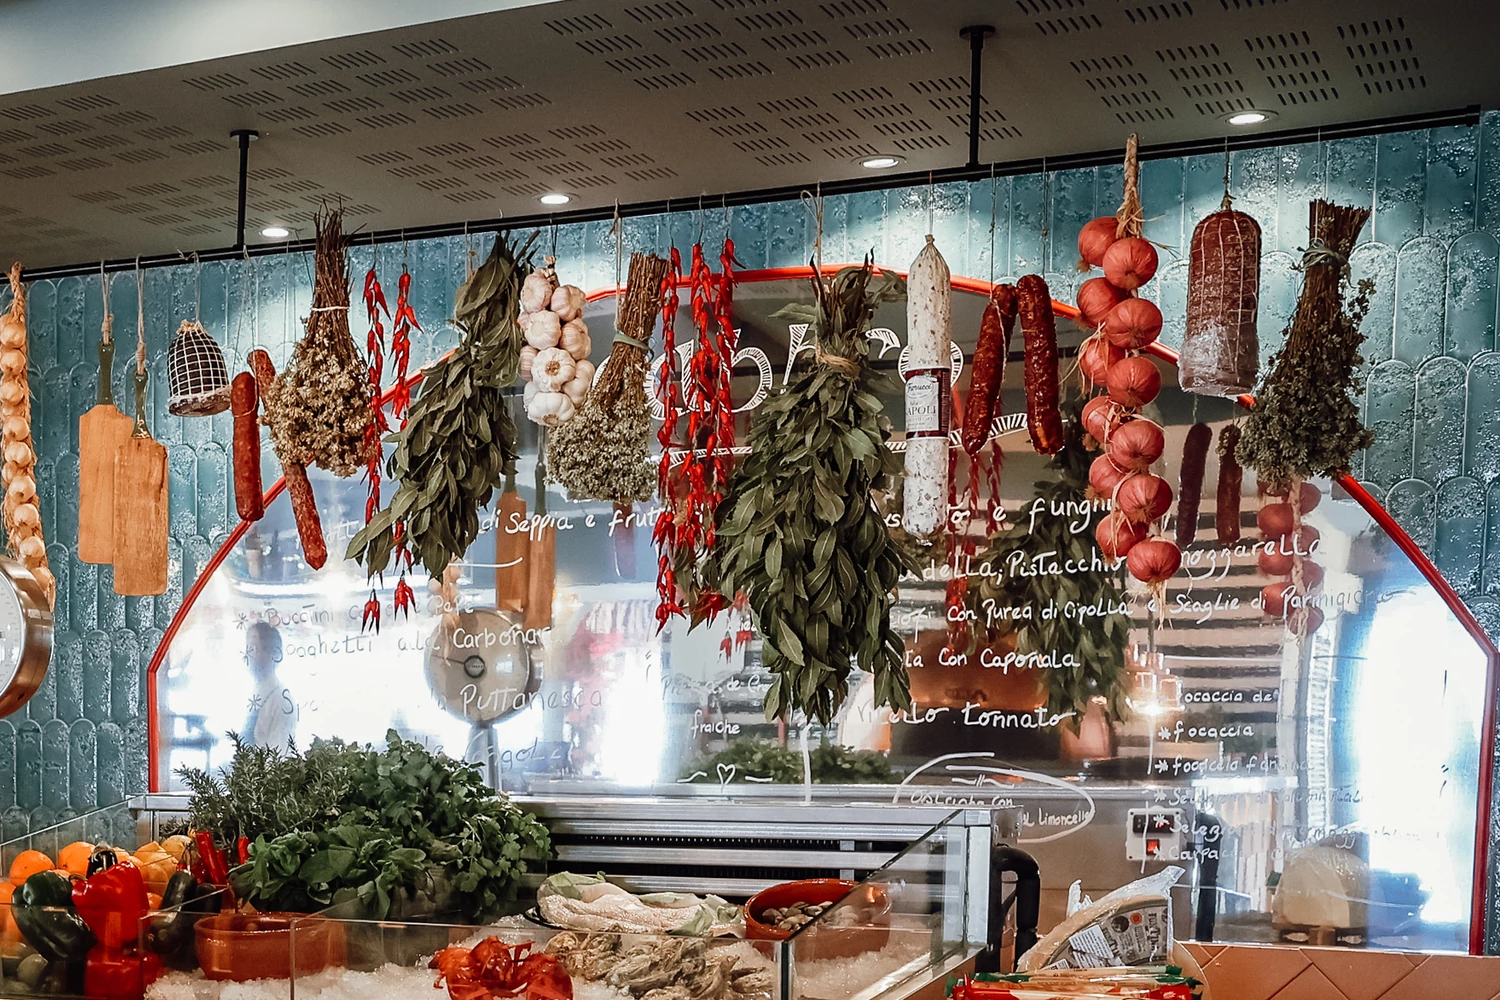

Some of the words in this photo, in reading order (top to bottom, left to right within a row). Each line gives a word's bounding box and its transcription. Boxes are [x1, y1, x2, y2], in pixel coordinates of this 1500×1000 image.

[905, 405, 936, 416] APOLI
[505, 508, 573, 541] Seppia
[584, 513, 596, 528] e
[608, 506, 664, 537] frut
[1042, 598, 1057, 619] di
[1251, 592, 1266, 611] di
